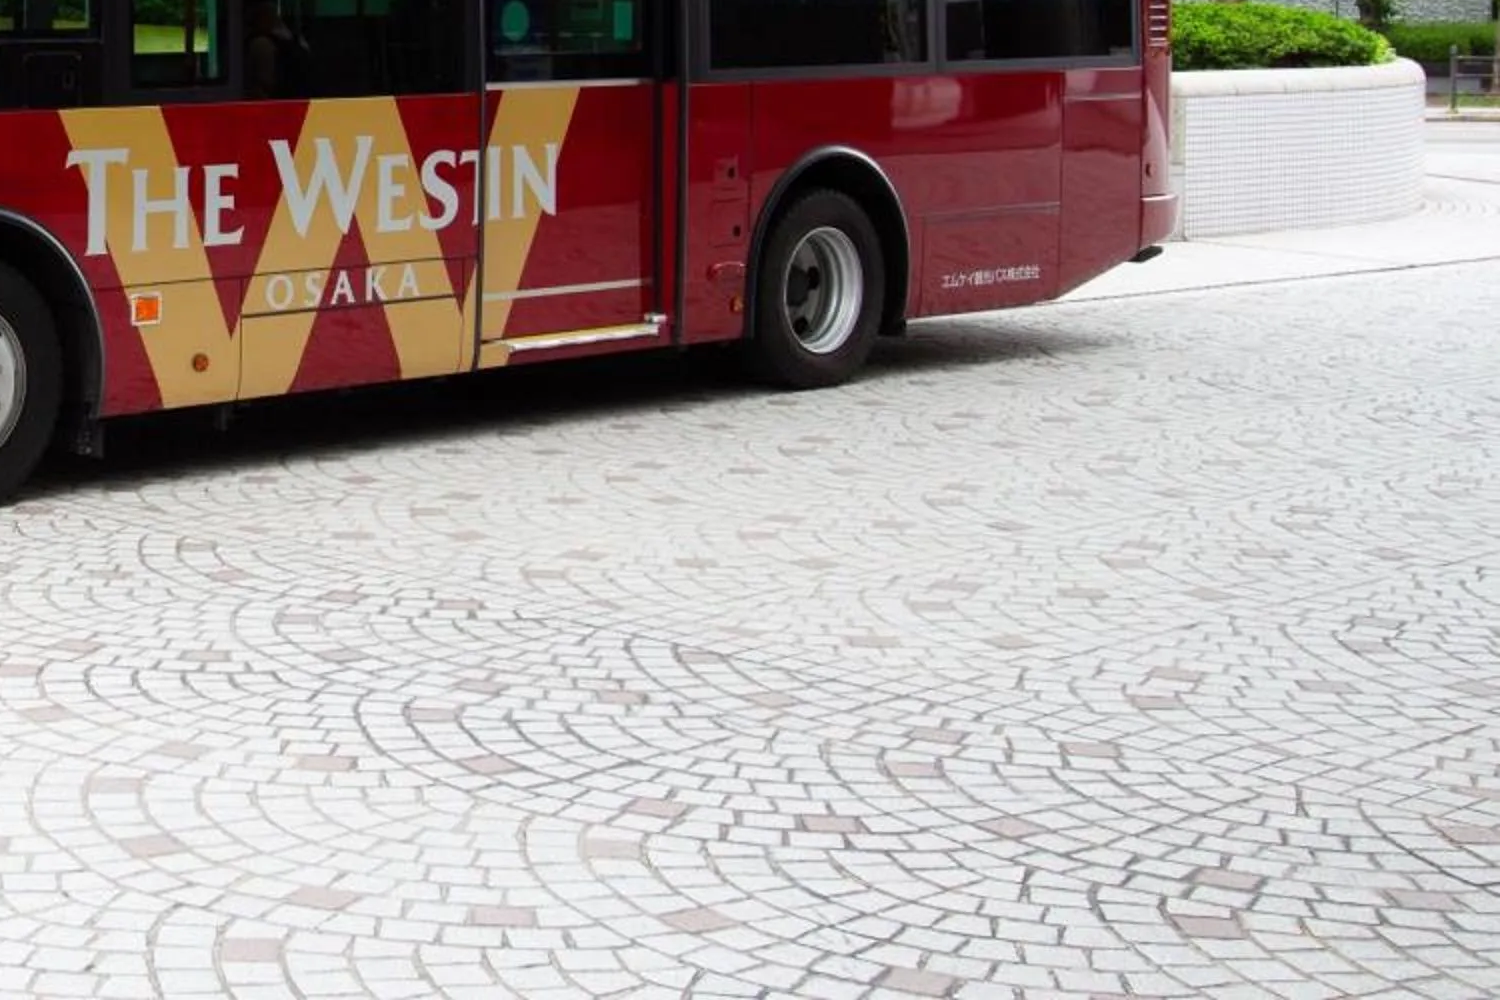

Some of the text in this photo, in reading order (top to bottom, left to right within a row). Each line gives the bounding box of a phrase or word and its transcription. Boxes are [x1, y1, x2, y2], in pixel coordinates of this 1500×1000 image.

[65, 135, 558, 256] THE WESTIN
[266, 264, 420, 310] OSAKA
